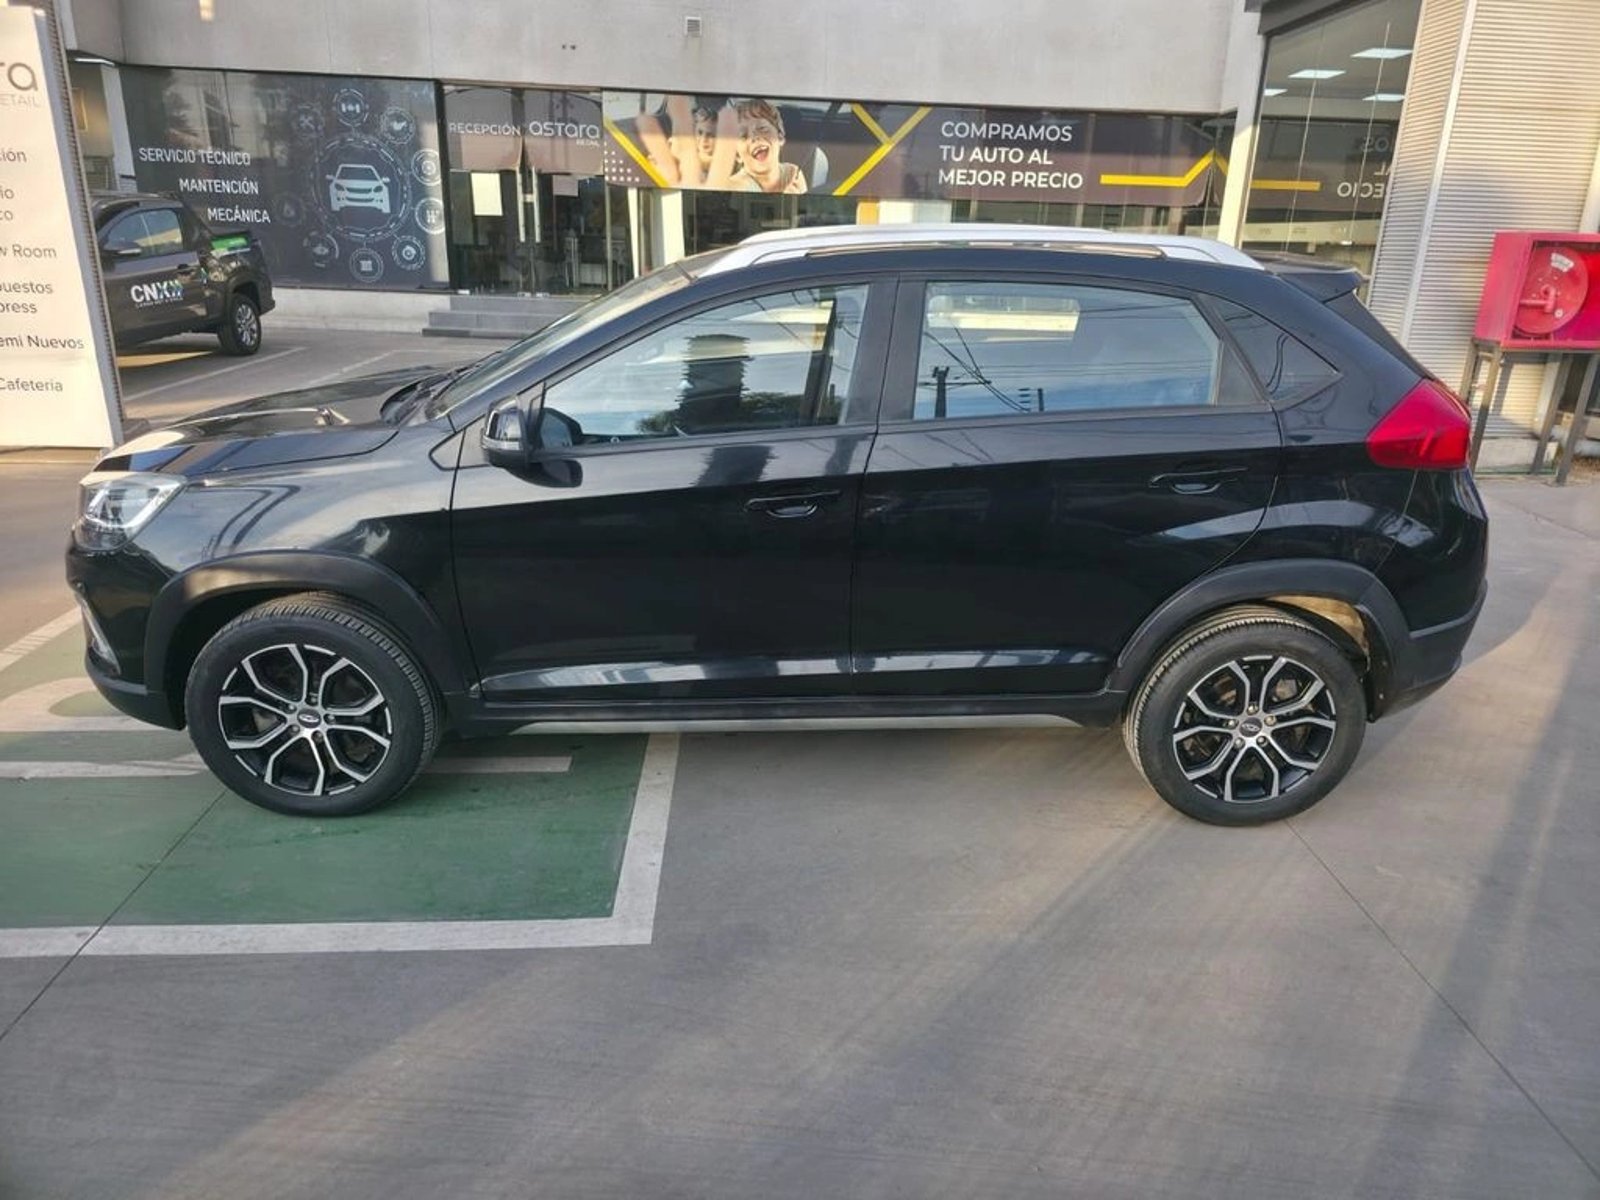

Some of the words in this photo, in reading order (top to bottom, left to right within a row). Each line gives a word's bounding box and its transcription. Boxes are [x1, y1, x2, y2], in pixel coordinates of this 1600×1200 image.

[449, 121, 522, 136] RECEPCIÓN
[941, 121, 1073, 142] COMPRAMOS
[139, 147, 195, 163] SERVICIO
[198, 147, 250, 166] TÉCNICO
[939, 145, 964, 162] TU
[969, 147, 1024, 164] AUTO
[1027, 149, 1054, 165] AL
[179, 177, 258, 195] MANTENCIÓN
[938, 169, 1006, 187] MEJOR
[1011, 171, 1083, 189] PRECIO
[207, 205, 271, 223] MECÁNICA
[12, 243, 57, 259] Room
[0, 281, 53, 294] uestos
[27, 335, 84, 349] Nuevos
